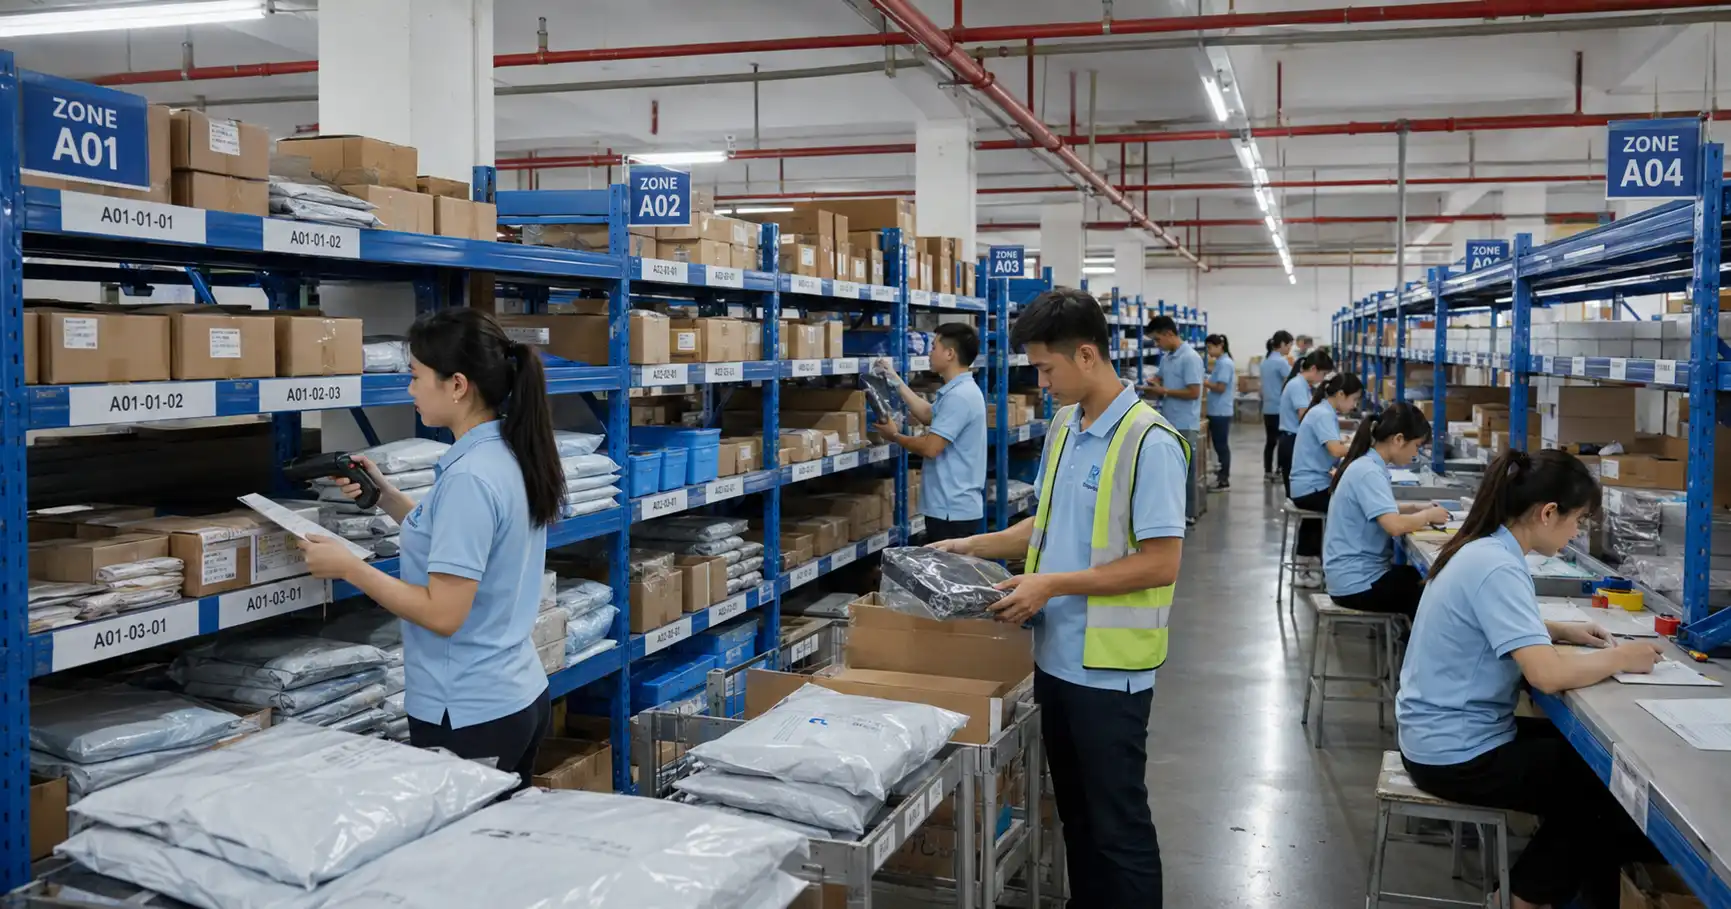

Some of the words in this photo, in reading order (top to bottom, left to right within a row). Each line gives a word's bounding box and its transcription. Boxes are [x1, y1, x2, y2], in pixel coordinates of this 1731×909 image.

[53, 96, 118, 129] ZONE
[52, 126, 118, 170] A01
[1622, 135, 1679, 153] ZONE
[1620, 158, 1684, 187] A04
[640, 177, 678, 190] ZONE
[638, 194, 681, 217] A02
[100, 205, 174, 231] A01-01-01
[290, 230, 341, 248] A01-01-02
[995, 250, 1018, 259] ZONE
[1472, 245, 1501, 256] ZONE
[995, 260, 1020, 273] A03
[109, 393, 184, 412] A01-01-02
[286, 386, 341, 402] A01-02-03
[244, 585, 303, 612] A01-03-01
[93, 617, 168, 650] A01-03-01
